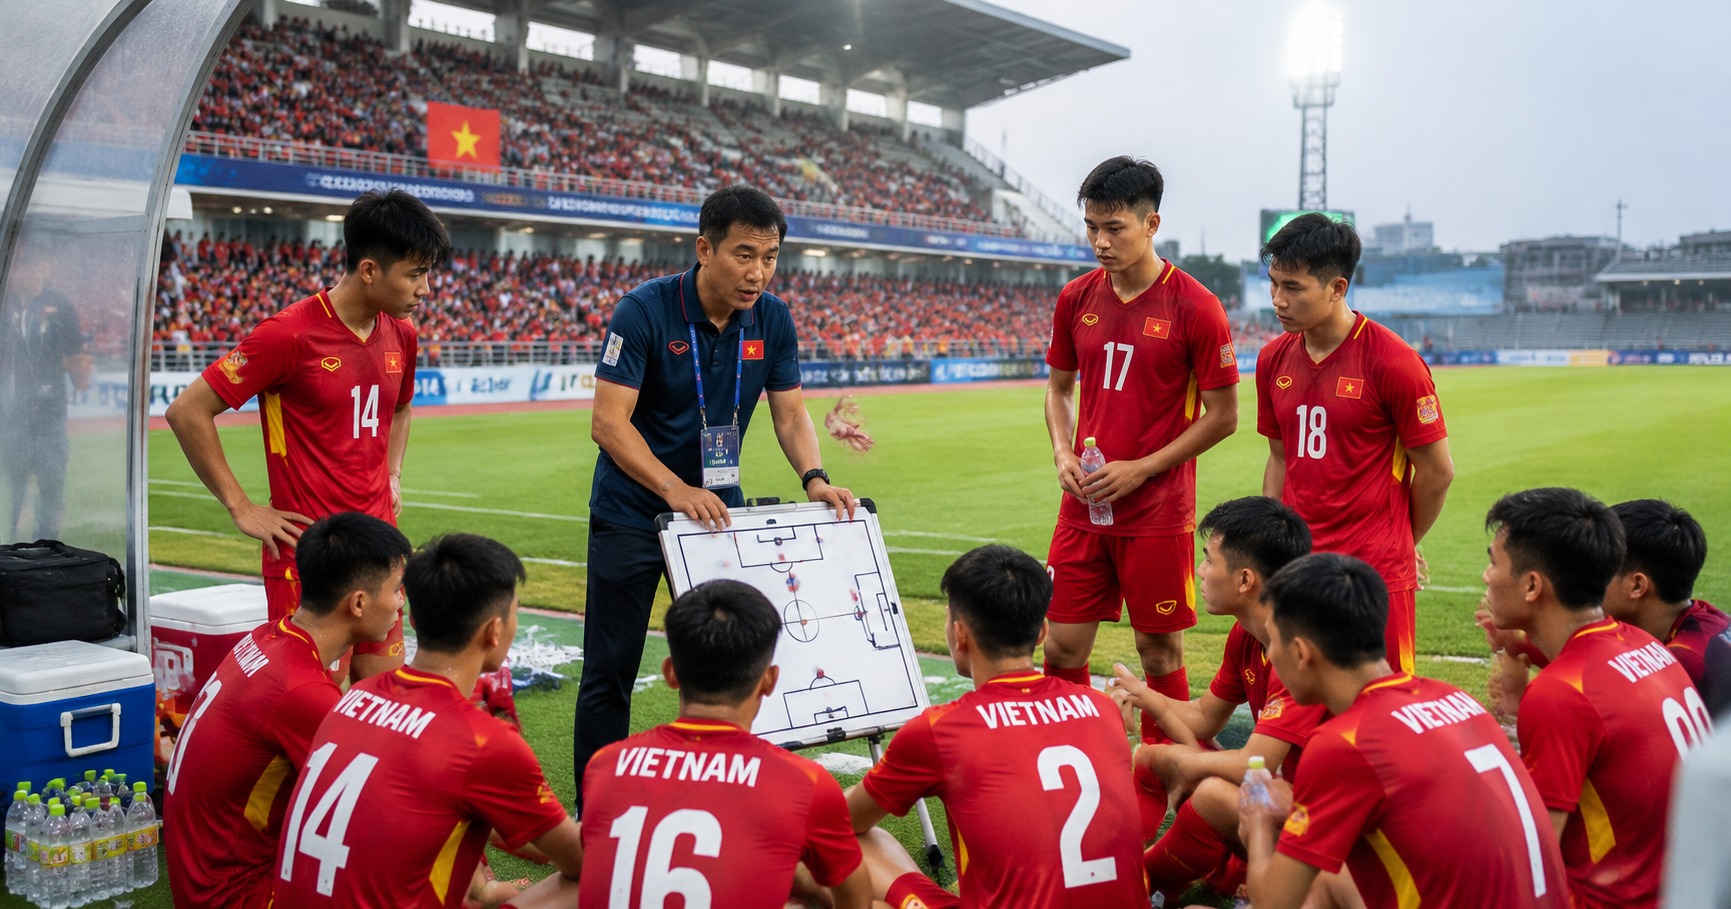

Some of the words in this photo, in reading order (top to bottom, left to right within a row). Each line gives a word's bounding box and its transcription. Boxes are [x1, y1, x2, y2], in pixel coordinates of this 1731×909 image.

[1102, 341, 1135, 391] 17
[350, 384, 380, 439] 14
[1296, 404, 1327, 460] 18
[333, 688, 437, 740] VIETNAM
[975, 694, 1101, 730] VIETNAM
[615, 746, 761, 788] VIETNAM
[280, 741, 379, 897] 14
[1036, 744, 1117, 889] 2
[1463, 743, 1546, 898] 7
[608, 805, 723, 909] 16
